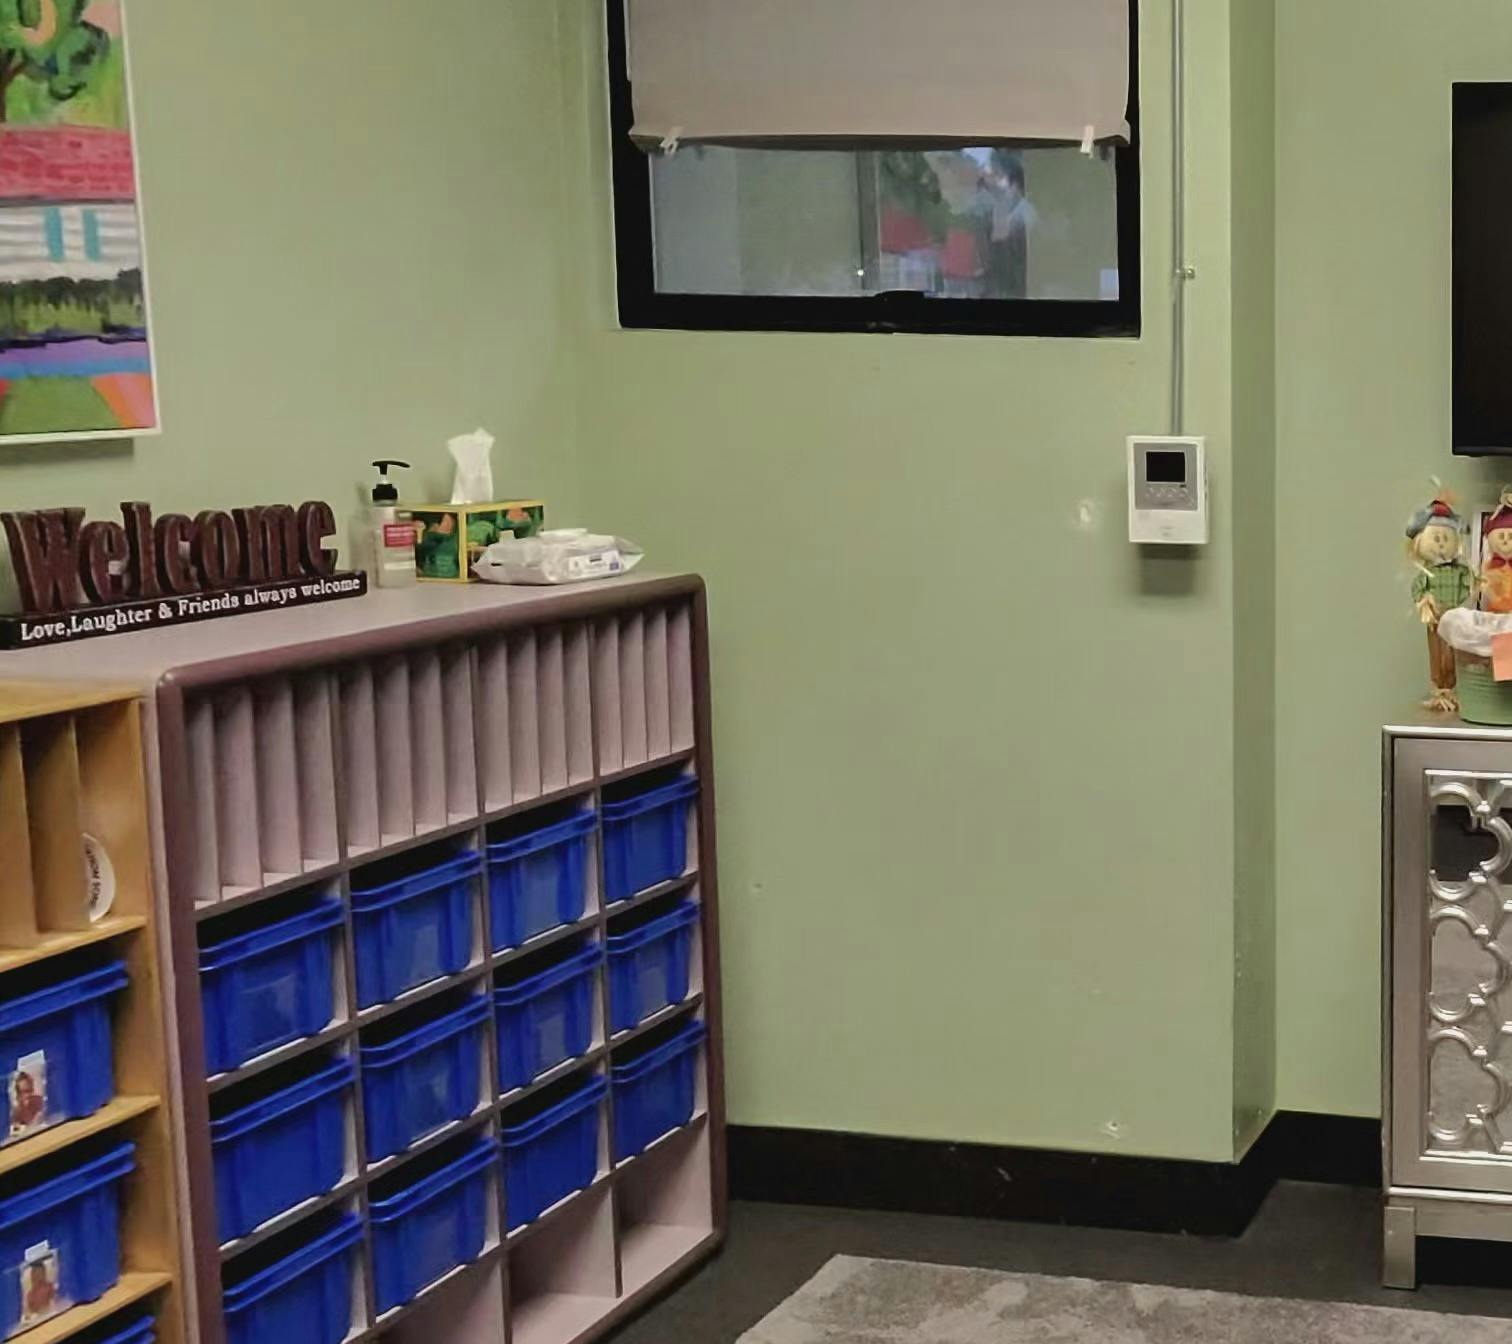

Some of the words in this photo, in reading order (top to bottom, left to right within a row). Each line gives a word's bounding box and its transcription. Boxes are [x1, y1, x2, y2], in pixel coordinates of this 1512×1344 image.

[0, 501, 338, 613] Welcome
[158, 602, 173, 619] &
[178, 592, 239, 616] Friends
[244, 589, 297, 604] always
[301, 578, 360, 596] welcome
